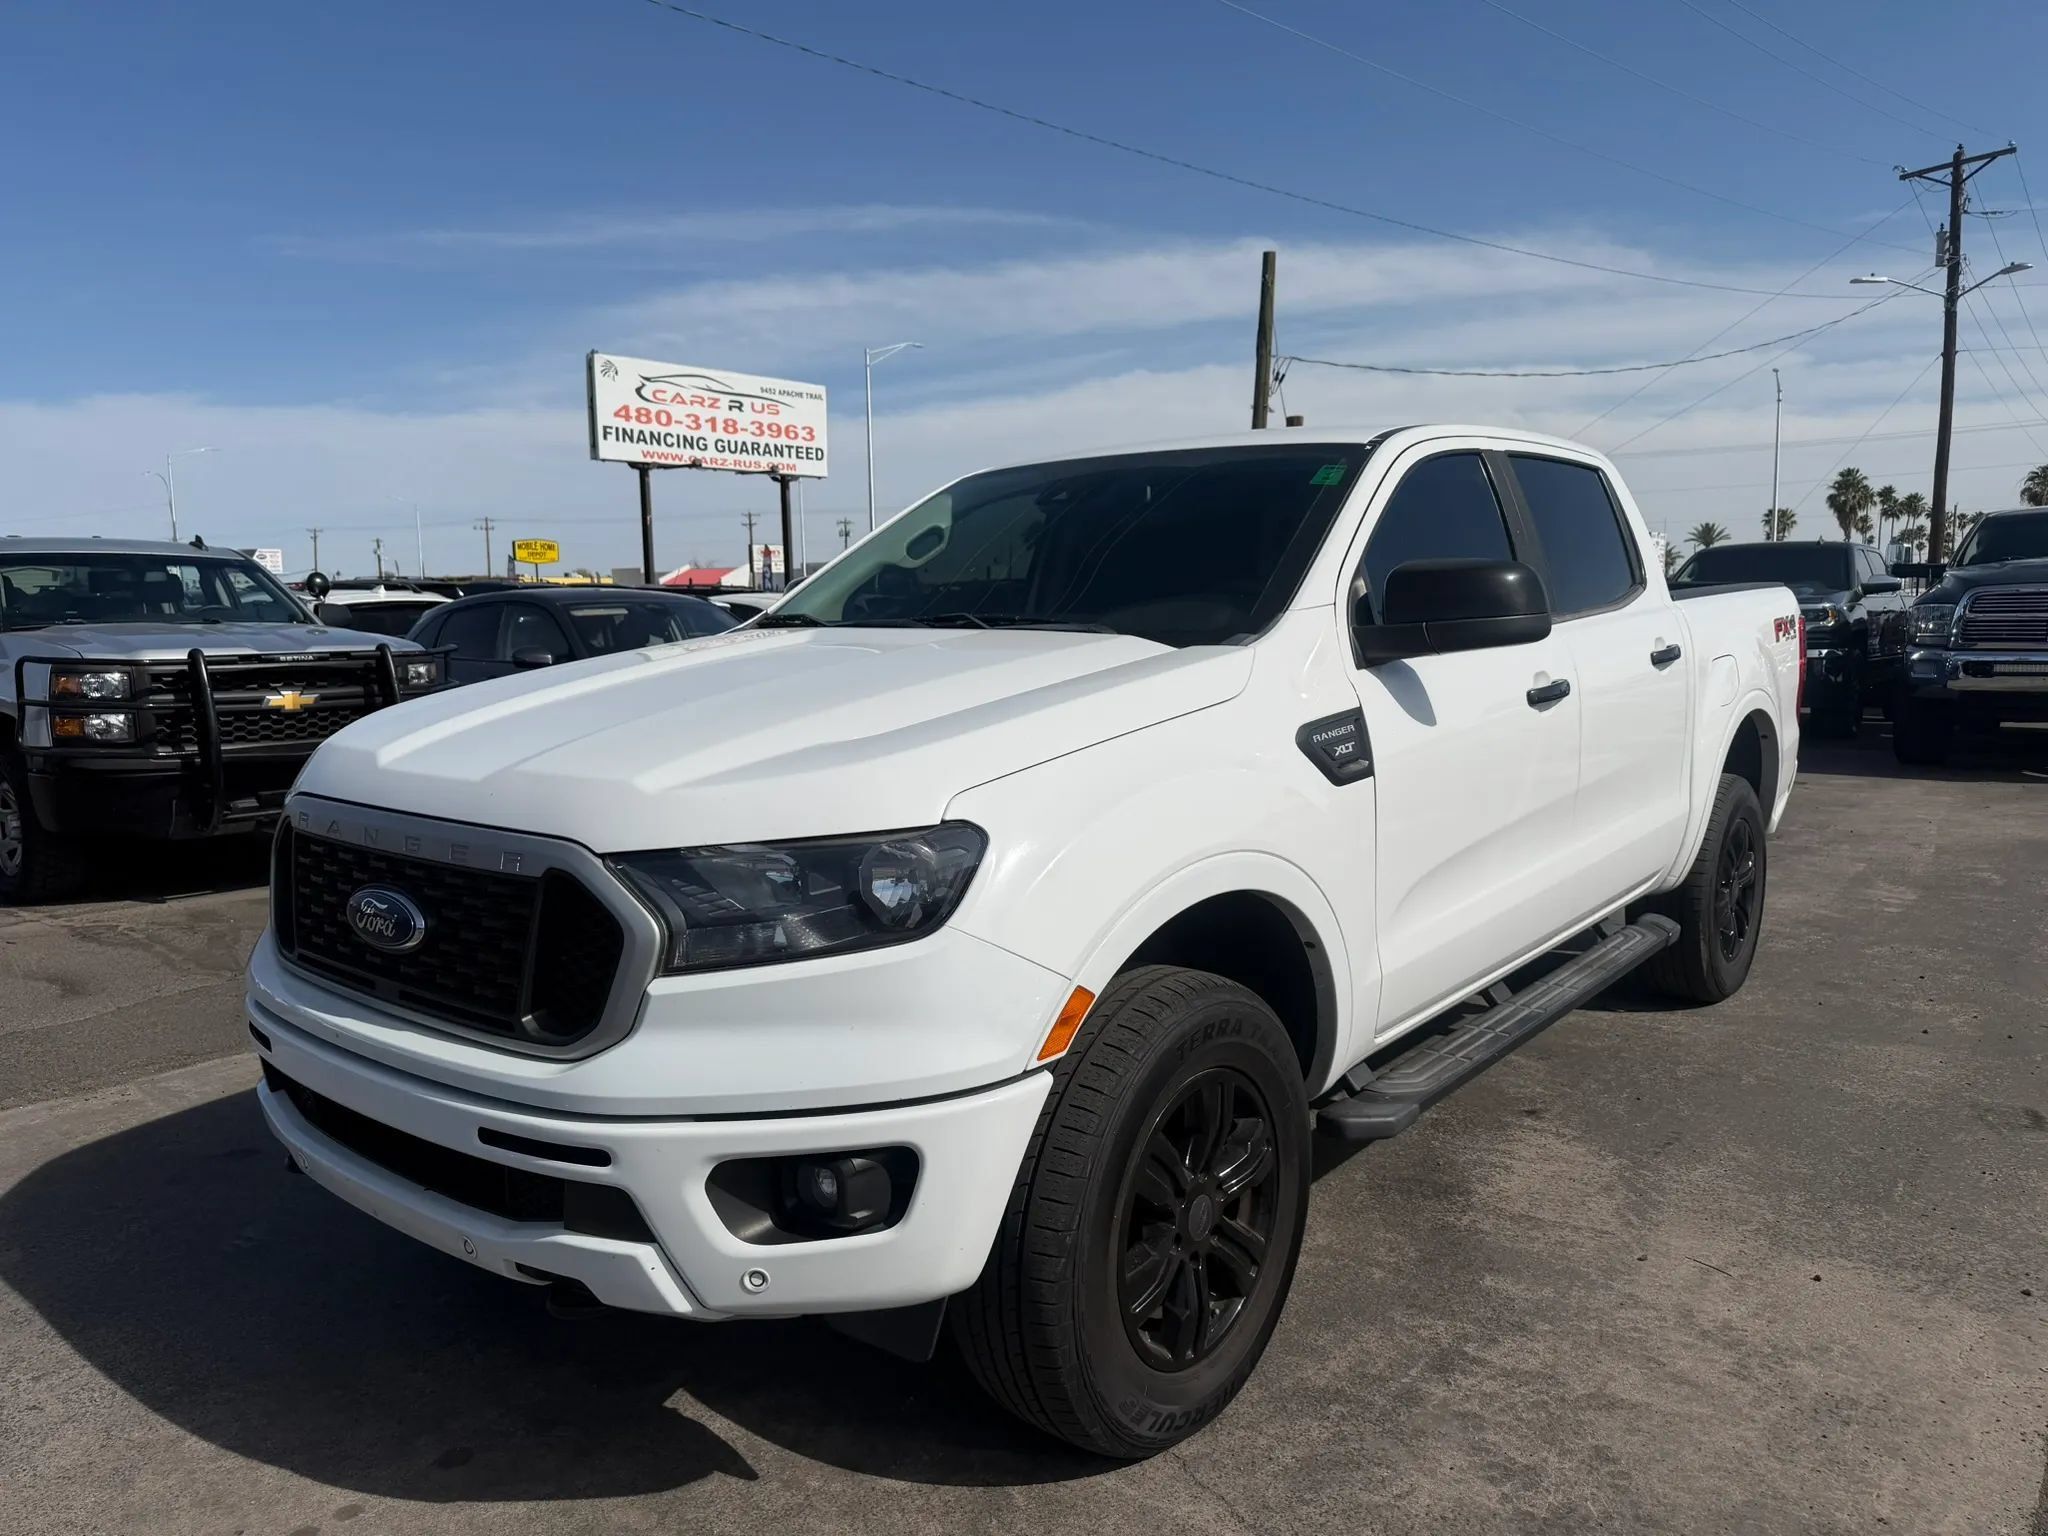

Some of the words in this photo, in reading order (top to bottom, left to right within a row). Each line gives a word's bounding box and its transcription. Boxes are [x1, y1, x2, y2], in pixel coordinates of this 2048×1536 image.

[652, 389, 720, 409] CARZ
[728, 400, 744, 412] R
[751, 402, 780, 415] US
[778, 389, 804, 399] APACHE
[805, 391, 824, 401] TRAIL
[613, 404, 815, 441] 480-318-3963
[602, 425, 708, 451] FINANCING
[714, 438, 824, 461] GUARANTEED
[1773, 614, 1796, 643] FX4
[1312, 724, 1356, 743] RANGER
[1333, 741, 1355, 757] XLT
[298, 811, 524, 871] RANGER
[356, 898, 398, 937] Ford
[1176, 1017, 1243, 1064] TERRA
